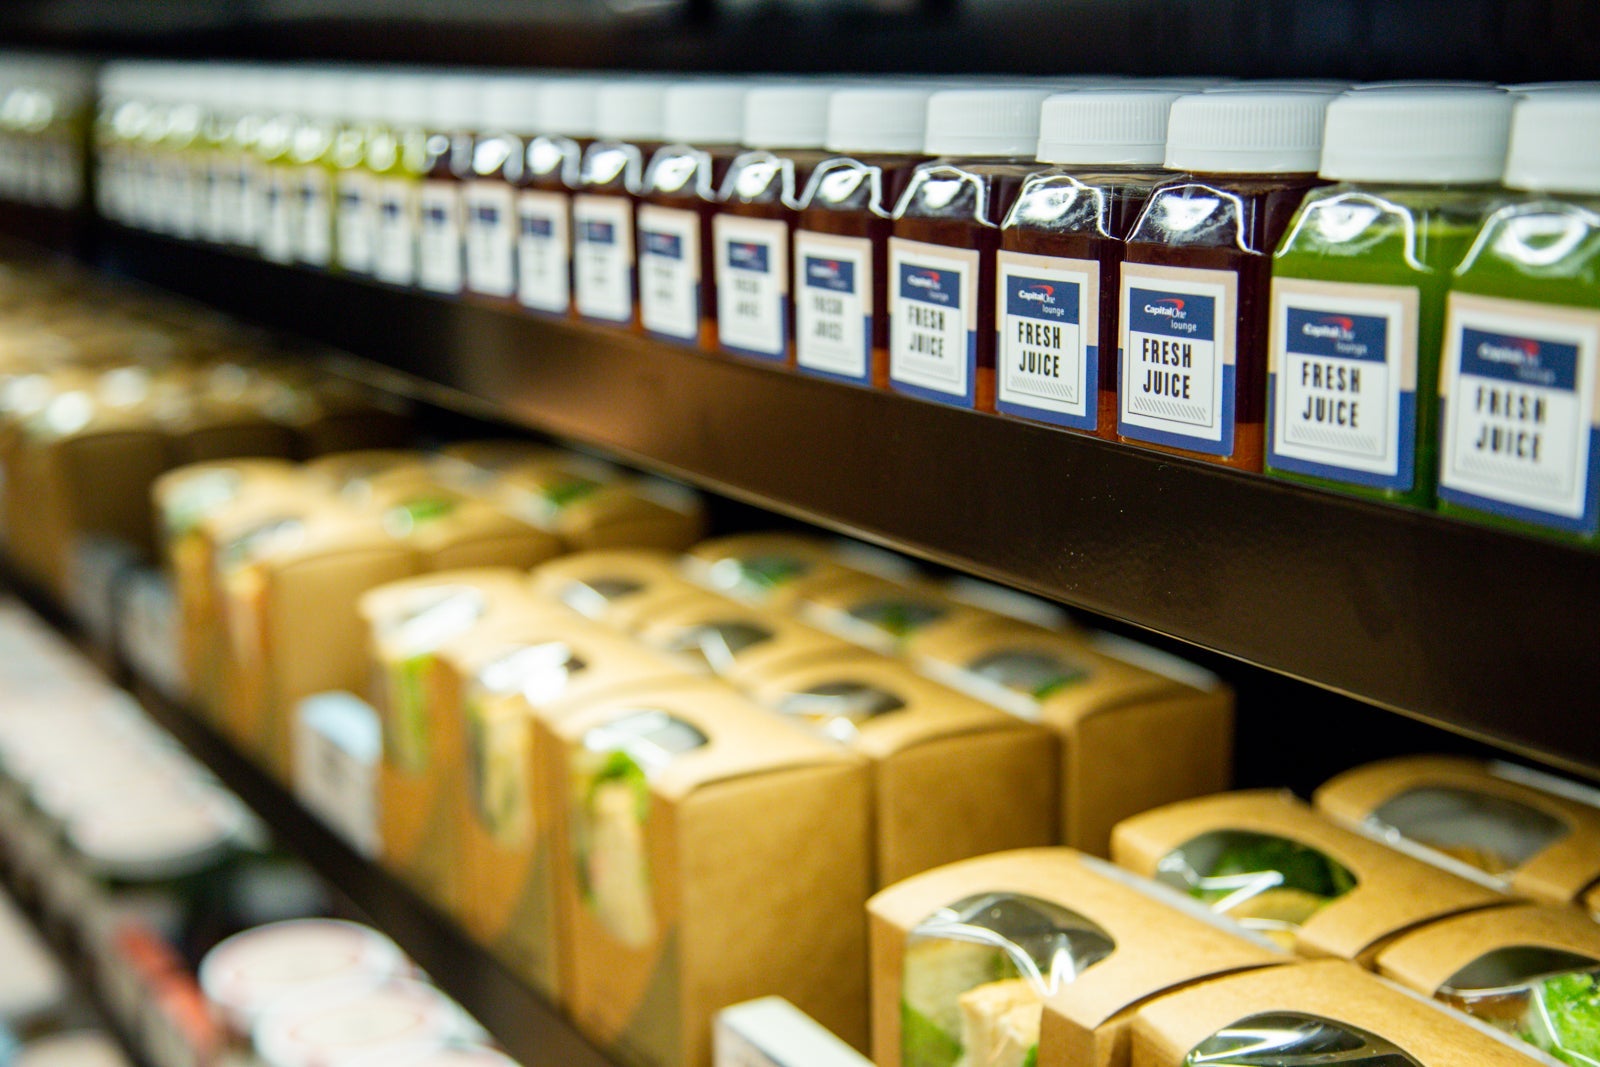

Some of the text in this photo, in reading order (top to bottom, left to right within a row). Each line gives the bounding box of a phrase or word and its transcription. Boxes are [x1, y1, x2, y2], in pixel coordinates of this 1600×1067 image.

[909, 306, 945, 331] FRESH
[1042, 304, 1064, 317] lounge
[1018, 321, 1061, 349] FRESH
[1171, 320, 1197, 333] lounge
[909, 334, 944, 358] JUICE
[1142, 338, 1192, 368] FRESH
[1019, 350, 1060, 378] JUICE
[1302, 361, 1361, 393] FRESH
[1143, 369, 1190, 399] JUICE
[1302, 396, 1359, 428] JUICE
[1476, 387, 1547, 422] FRESH
[1476, 425, 1543, 461] JUICE
